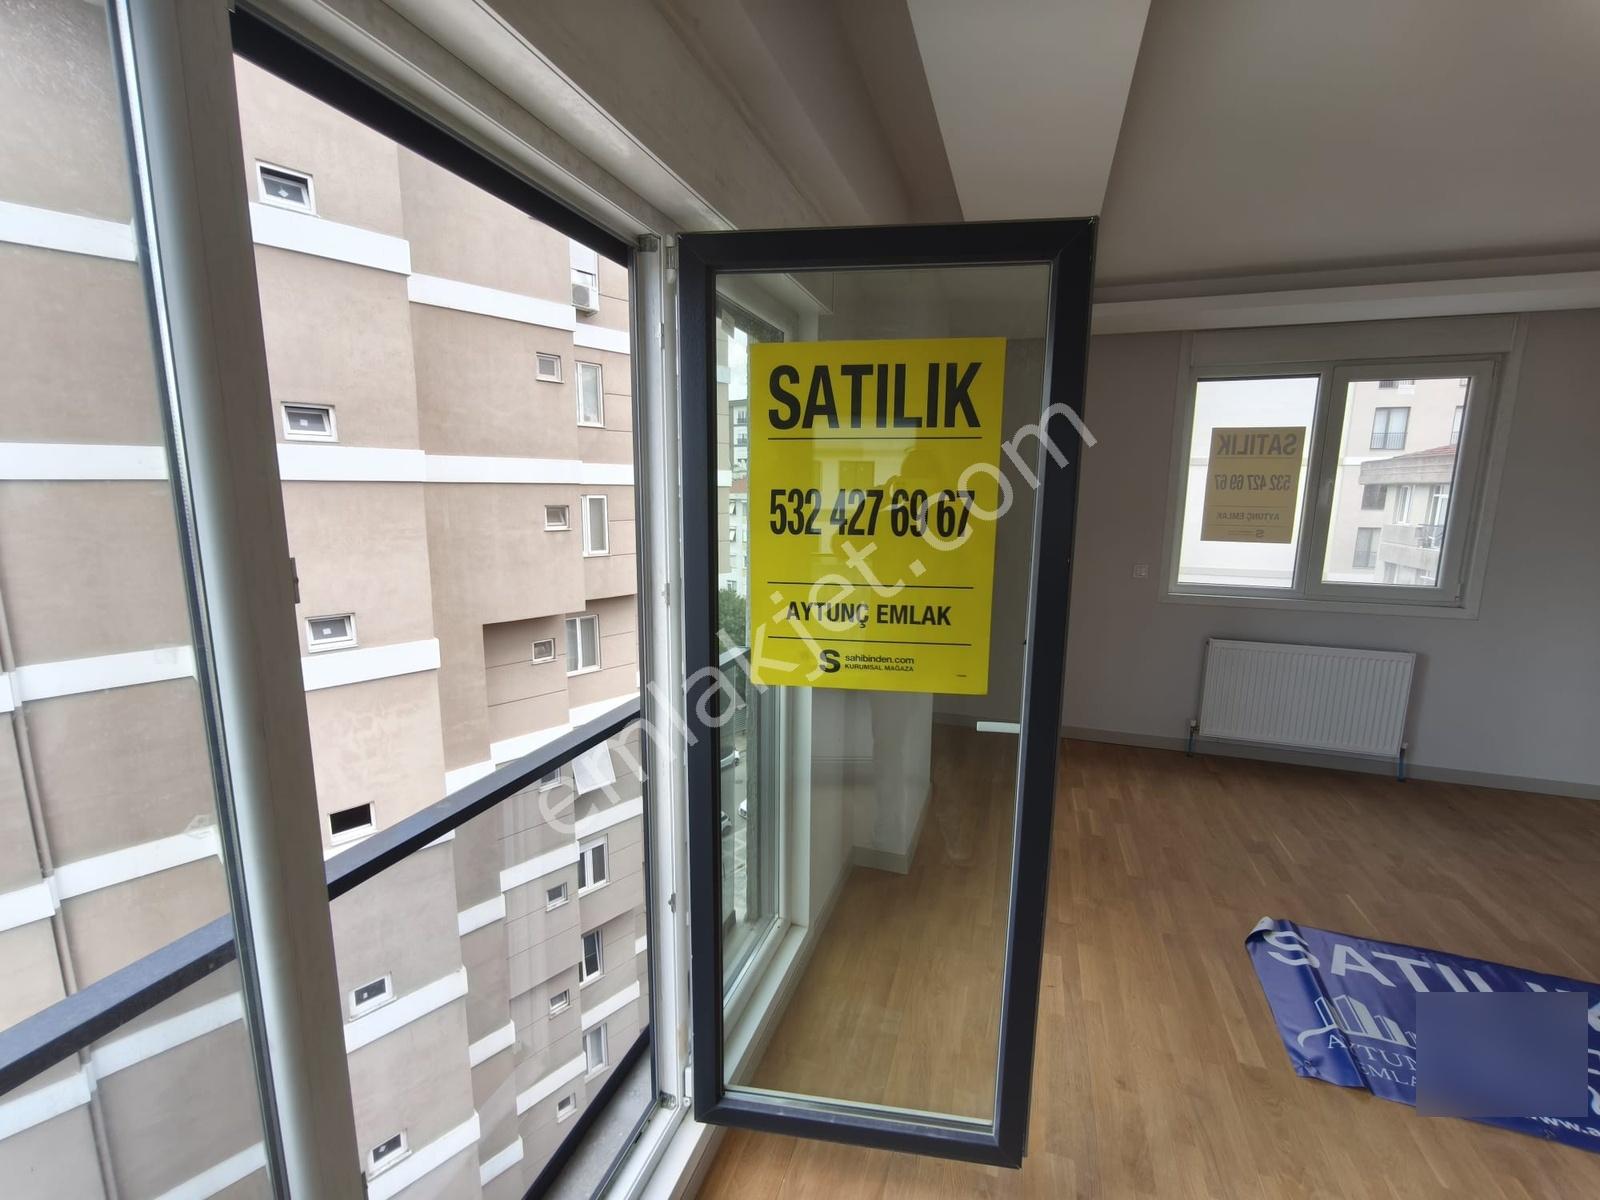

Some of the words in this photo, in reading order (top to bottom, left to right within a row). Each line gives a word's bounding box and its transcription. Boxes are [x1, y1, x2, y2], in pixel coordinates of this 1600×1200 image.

[768, 362, 983, 430] SATILIK
[770, 488, 822, 536] 532
[830, 488, 884, 537] 427
[891, 488, 929, 538] 69
[936, 488, 976, 538] 67
[786, 601, 869, 629] AYTUNÇ
[876, 604, 952, 627] EMLAK
[819, 649, 842, 674] S
[844, 654, 915, 665] sahibinden.com
[844, 663, 882, 671] KURUMSAL
